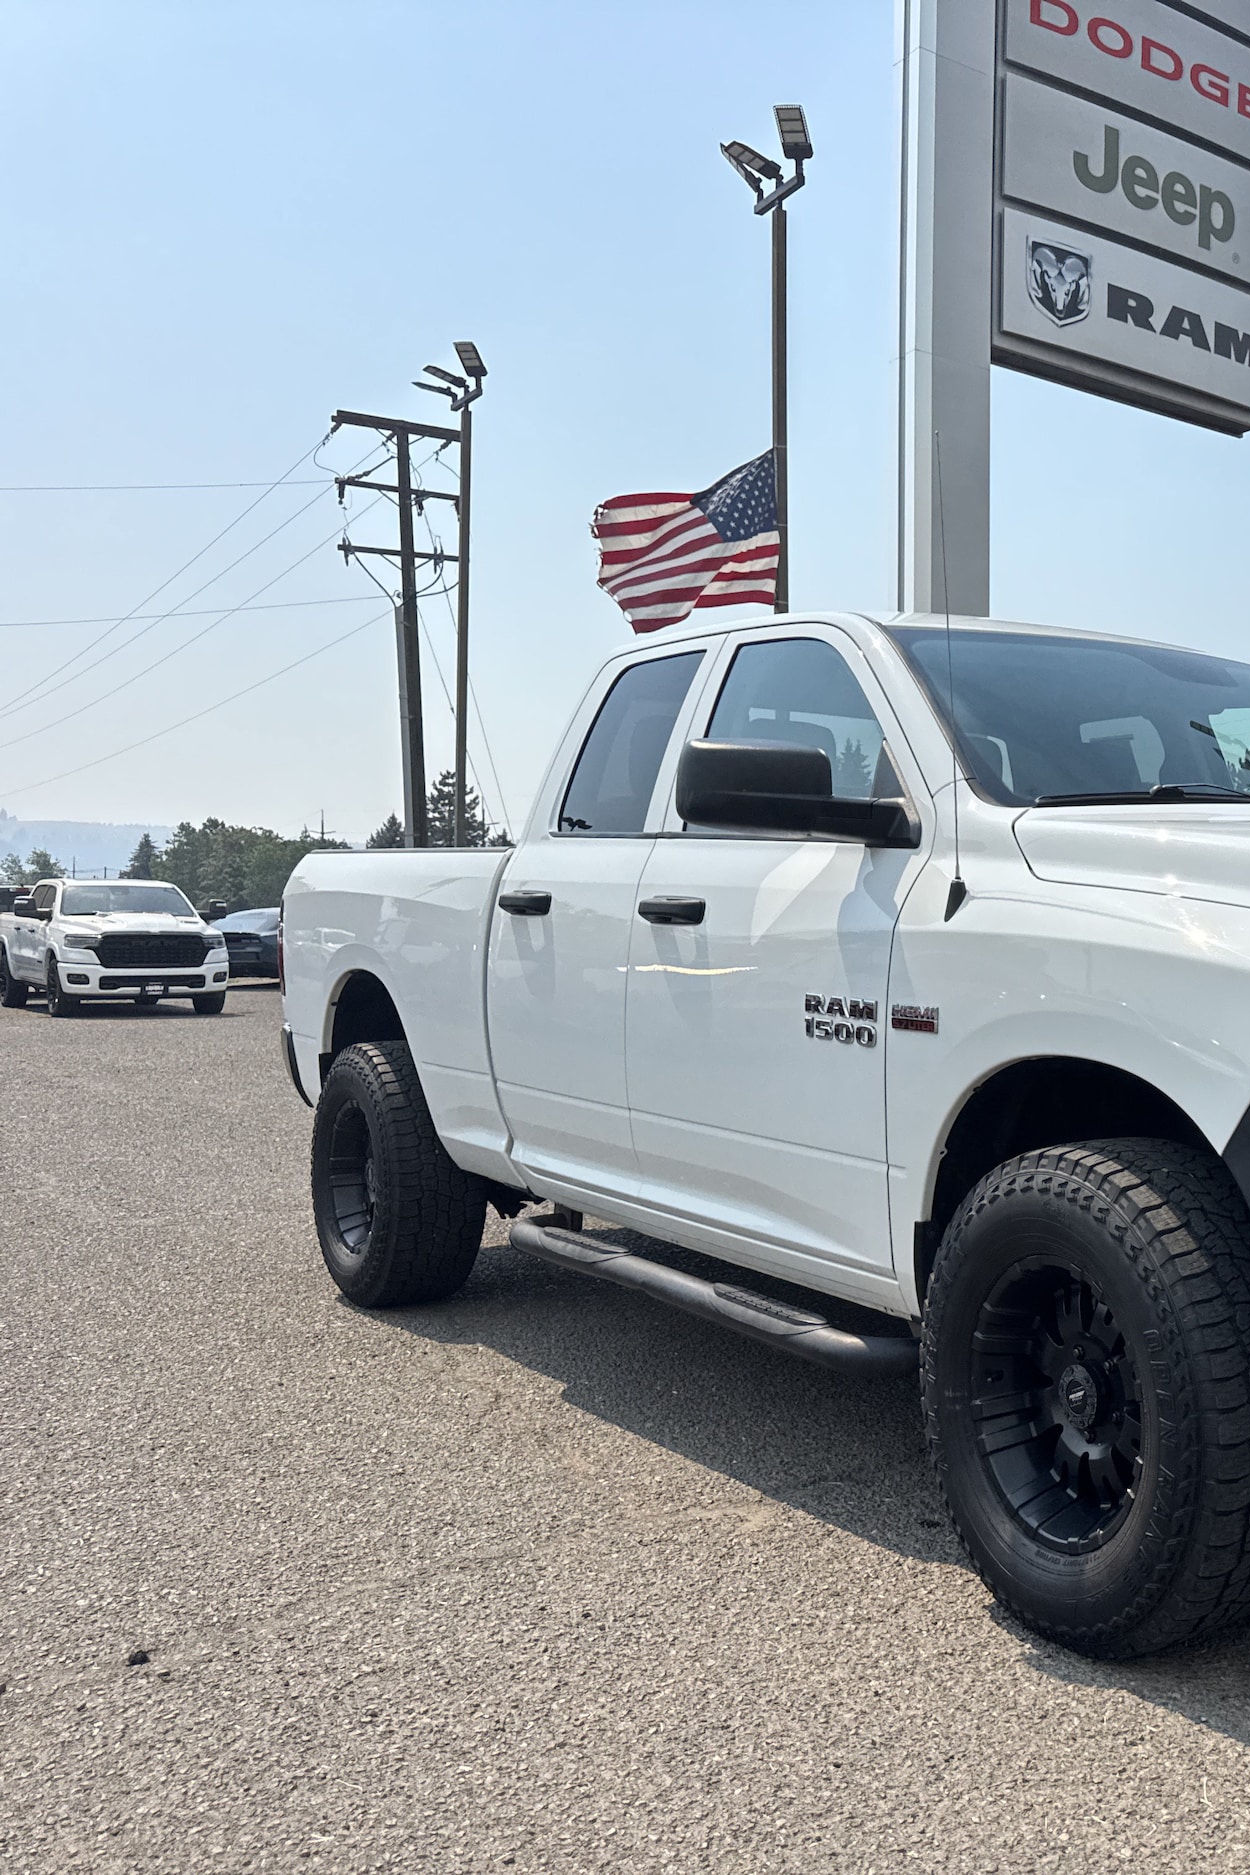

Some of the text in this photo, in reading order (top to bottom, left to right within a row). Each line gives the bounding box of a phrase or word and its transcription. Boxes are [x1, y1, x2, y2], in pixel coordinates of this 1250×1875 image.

[1073, 124, 1235, 250] Jeep
[804, 991, 878, 1022] RAM
[891, 1003, 939, 1020] HEMI
[804, 1016, 878, 1048] 1500
